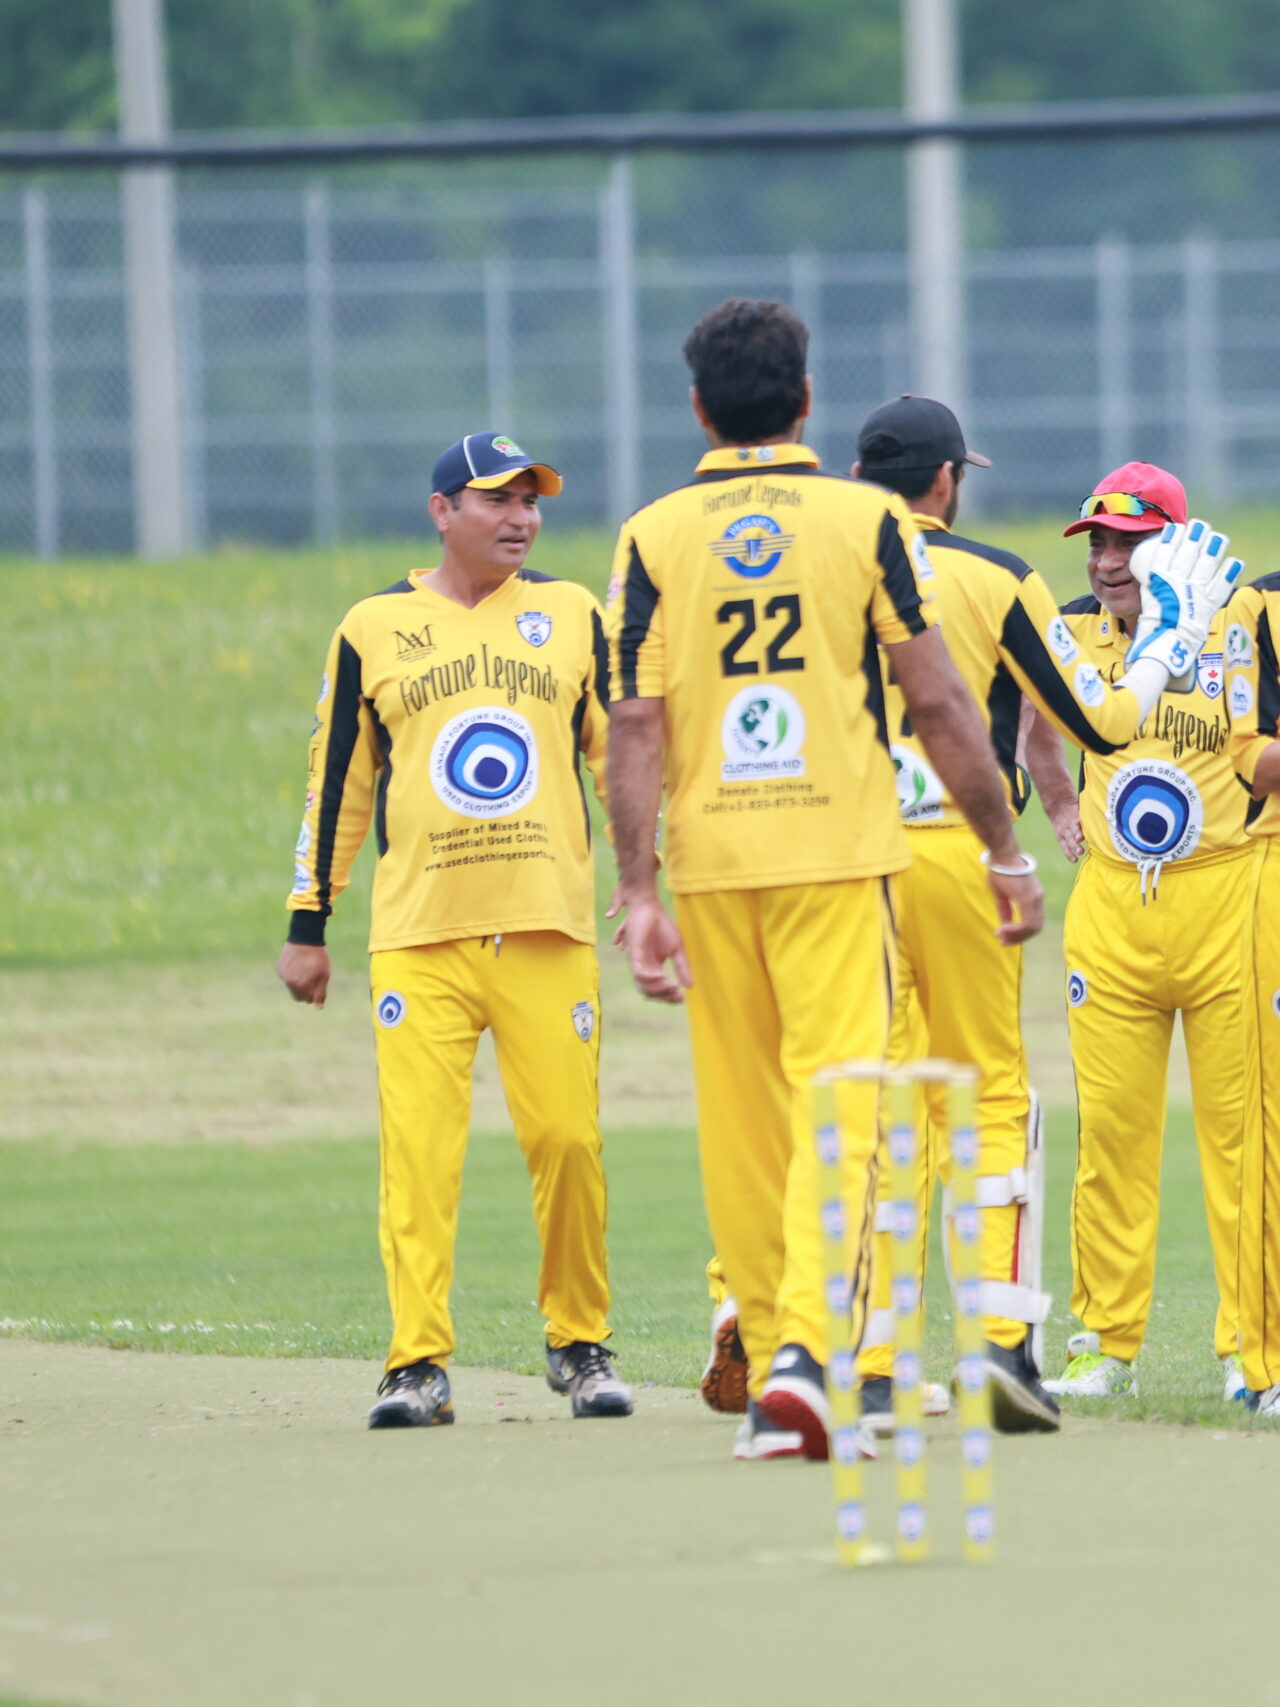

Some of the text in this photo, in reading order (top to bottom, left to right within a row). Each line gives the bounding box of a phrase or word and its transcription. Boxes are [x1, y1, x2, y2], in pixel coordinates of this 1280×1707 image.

[716, 593, 805, 678] 22
[400, 642, 560, 717] Fortune Legends
[1154, 691, 1227, 760] Legends
[436, 740, 450, 778] CANADA
[449, 713, 490, 737] FORTUNE
[493, 713, 525, 730] GROUP
[723, 759, 802, 774] CLOTHING AID
[1118, 766, 1154, 786] FORTUNE
[1157, 767, 1186, 786] GROUP
[442, 786, 462, 805] USED
[463, 801, 510, 812] CLOTHING
[920, 804, 940, 815] AID
[428, 828, 470, 842] Supplier
[473, 824, 485, 834] of
[488, 821, 520, 833] Mixed
[431, 839, 484, 855] Credential
[487, 834, 513, 846] Used
[1171, 823, 1196, 859] EXPORTS
